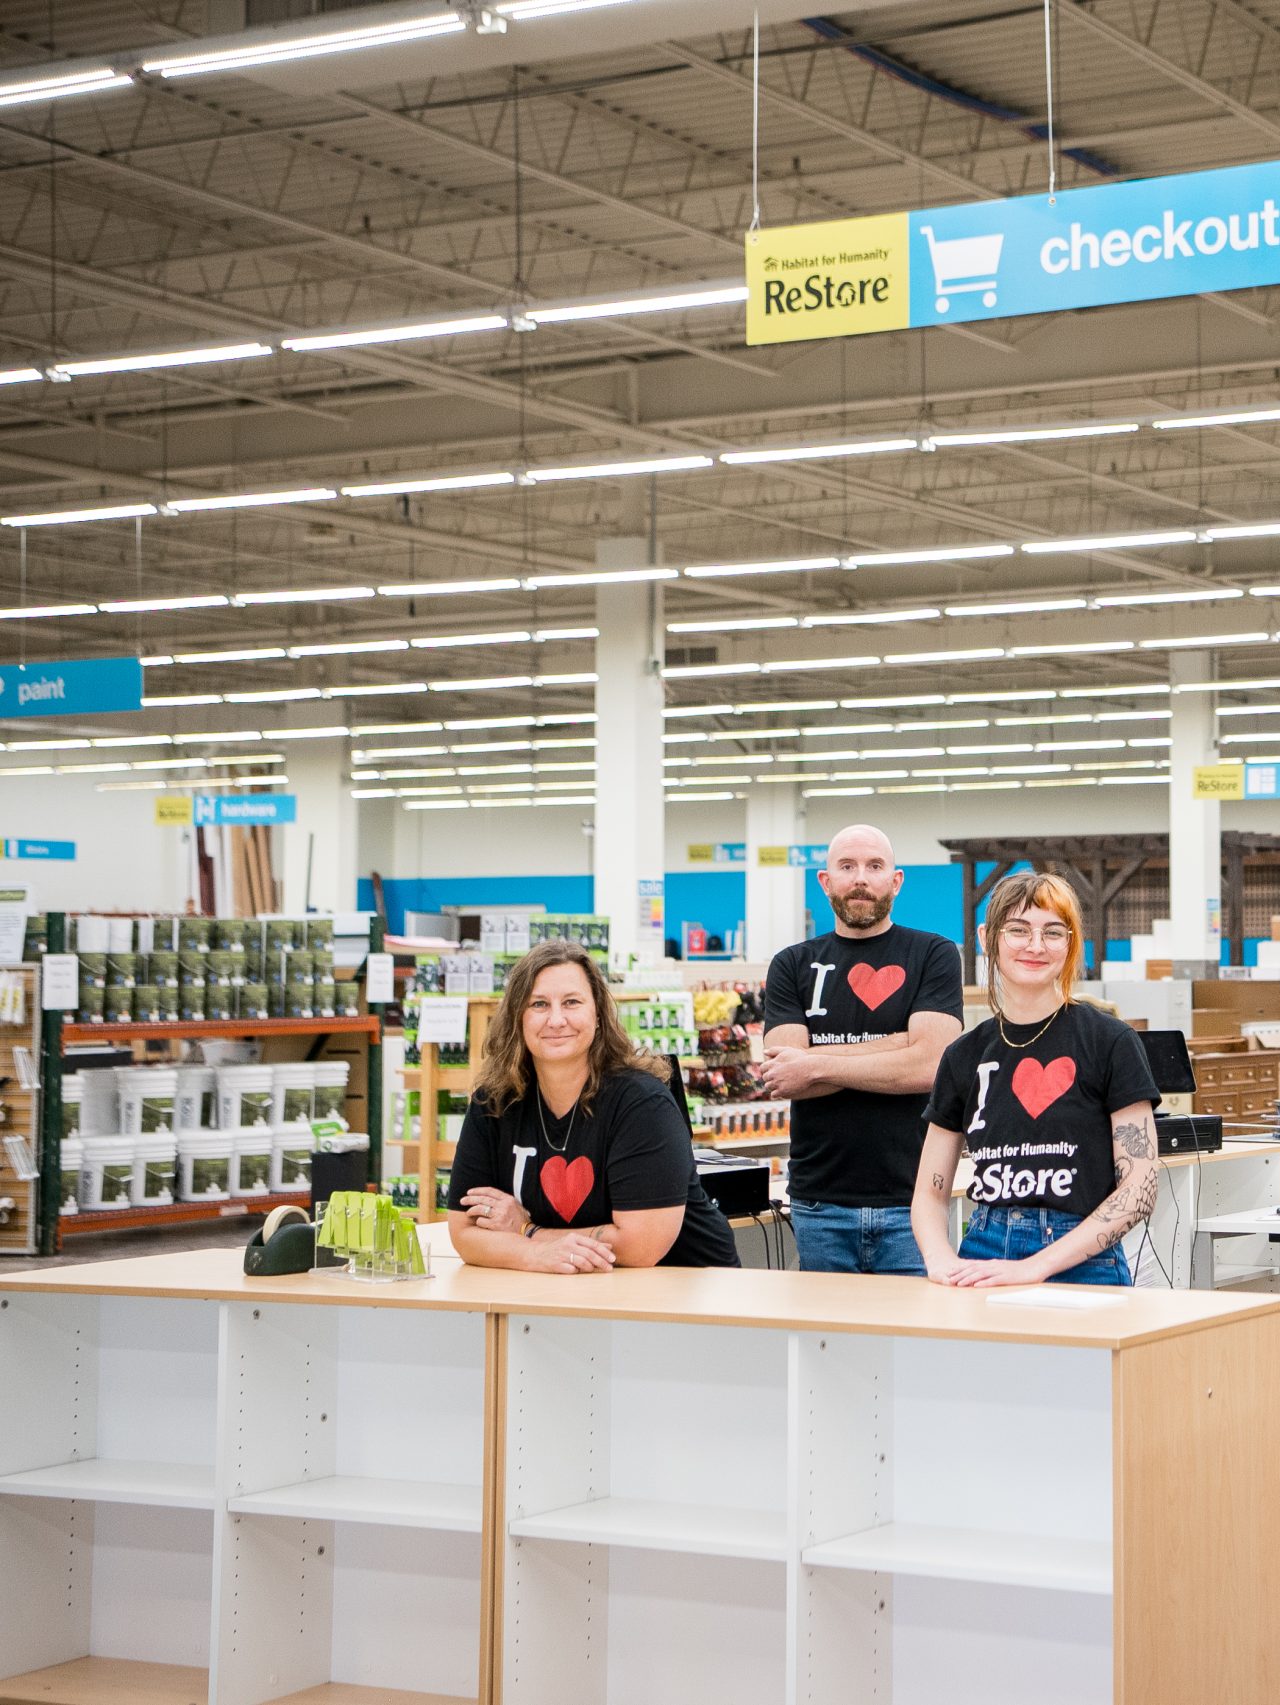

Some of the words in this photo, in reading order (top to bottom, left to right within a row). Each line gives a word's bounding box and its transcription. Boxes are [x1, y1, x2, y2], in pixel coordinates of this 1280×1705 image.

[1040, 199, 1280, 275] checkout
[781, 256, 819, 271] Habitat
[822, 255, 836, 266] for
[839, 249, 890, 265] Humanity
[765, 274, 889, 316] ReStore
[18, 676, 66, 705] paint
[1197, 780, 1238, 793] ReStore
[805, 962, 836, 1017] I
[847, 1033, 861, 1044] for
[967, 1061, 1000, 1134] I
[1003, 1145, 1020, 1158] for
[1021, 1141, 1076, 1157] Humanity
